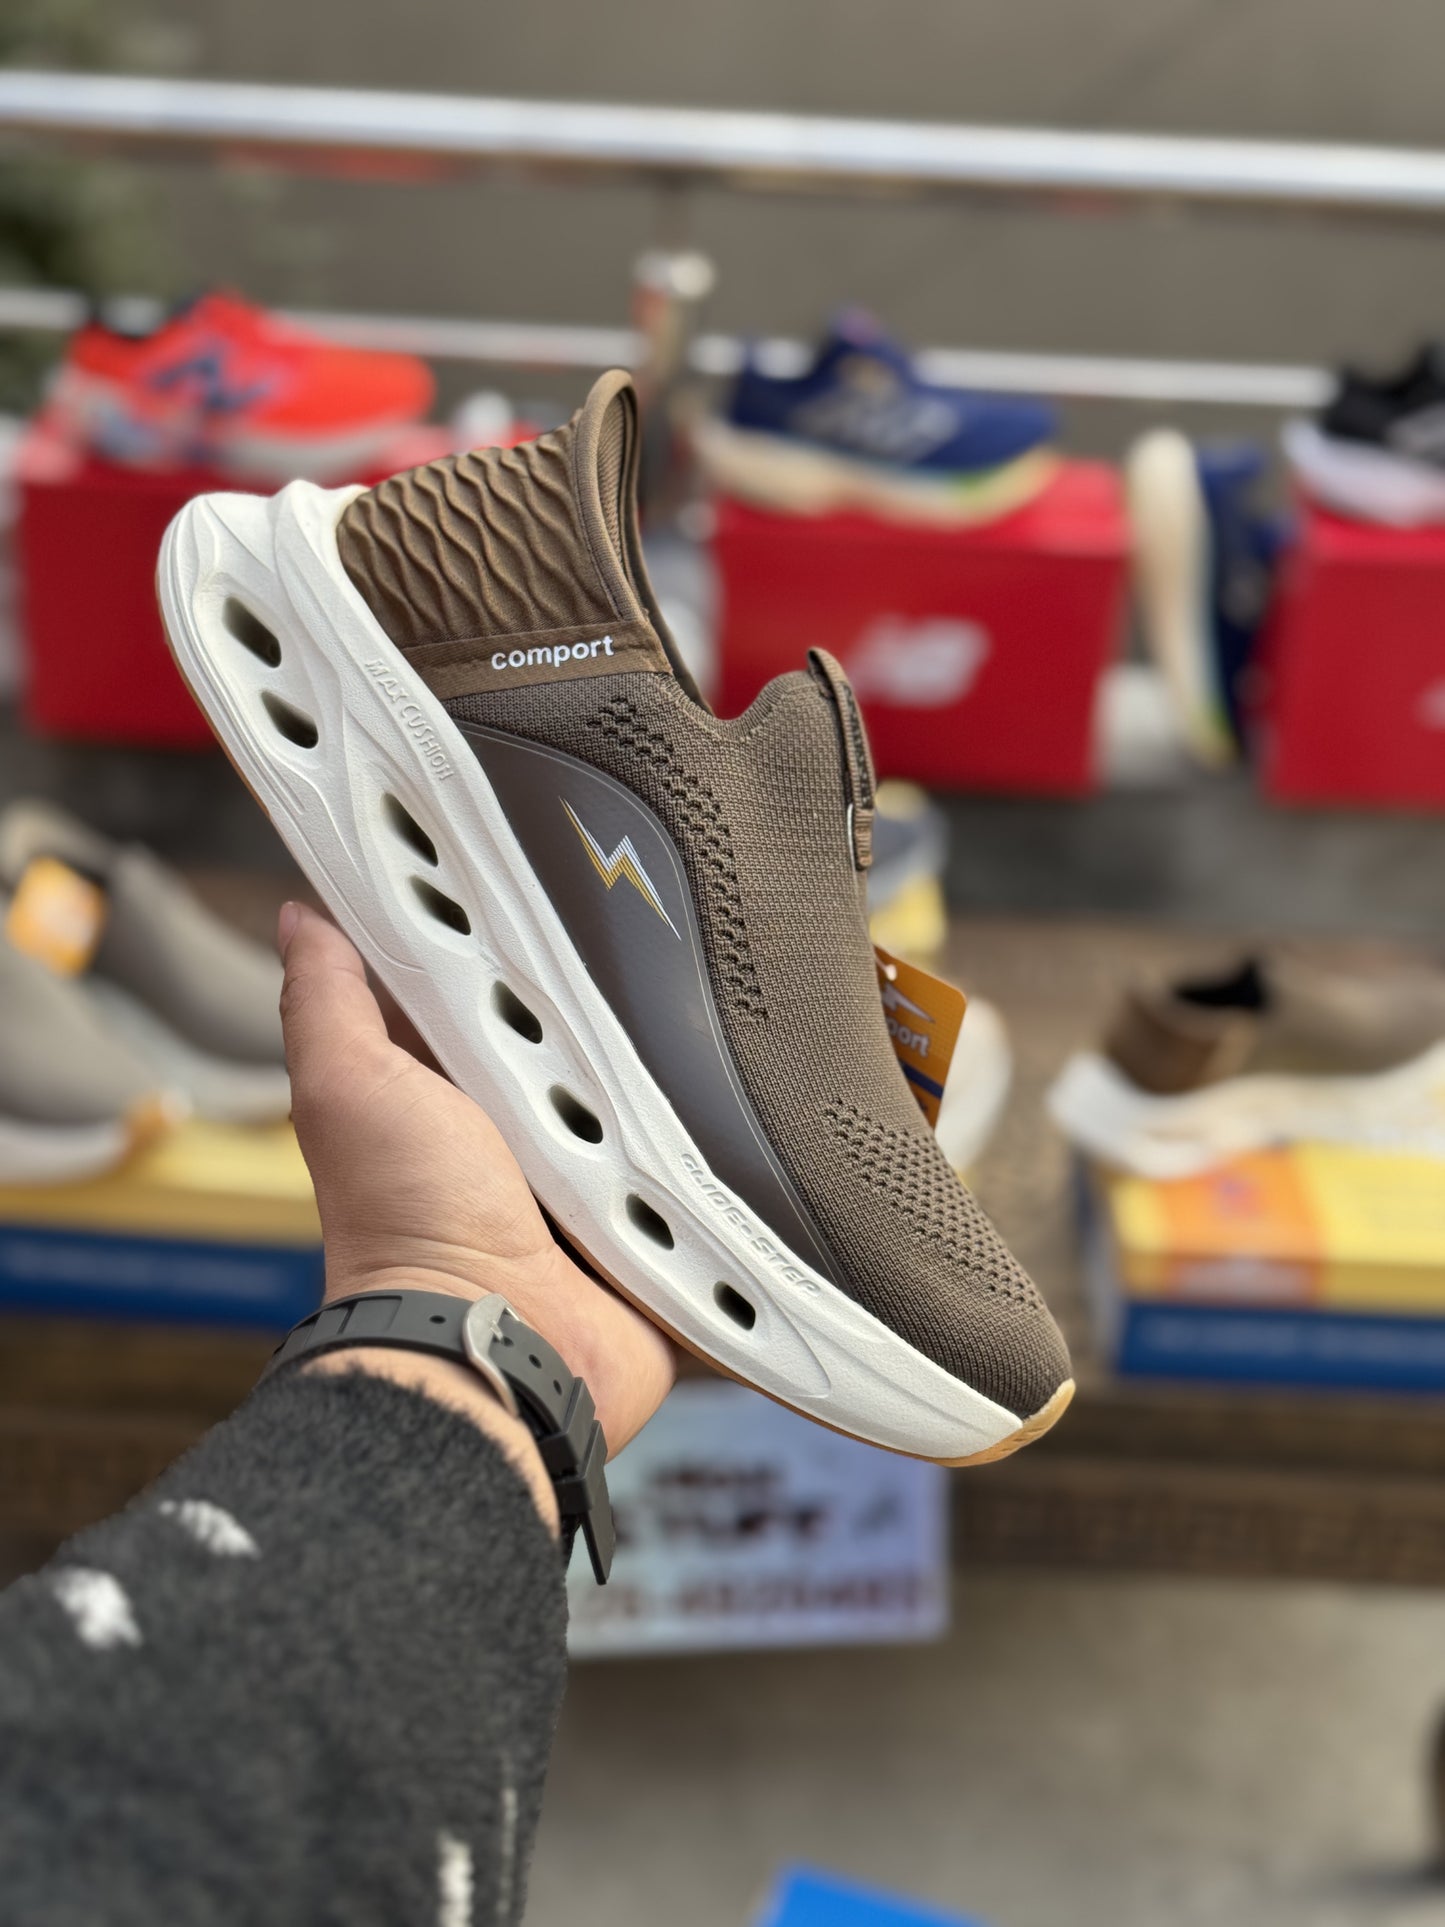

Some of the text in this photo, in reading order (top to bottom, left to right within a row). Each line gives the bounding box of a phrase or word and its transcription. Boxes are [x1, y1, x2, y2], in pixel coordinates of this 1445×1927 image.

[491, 635, 614, 670] comport
[365, 658, 454, 781] MAX CUSHION
